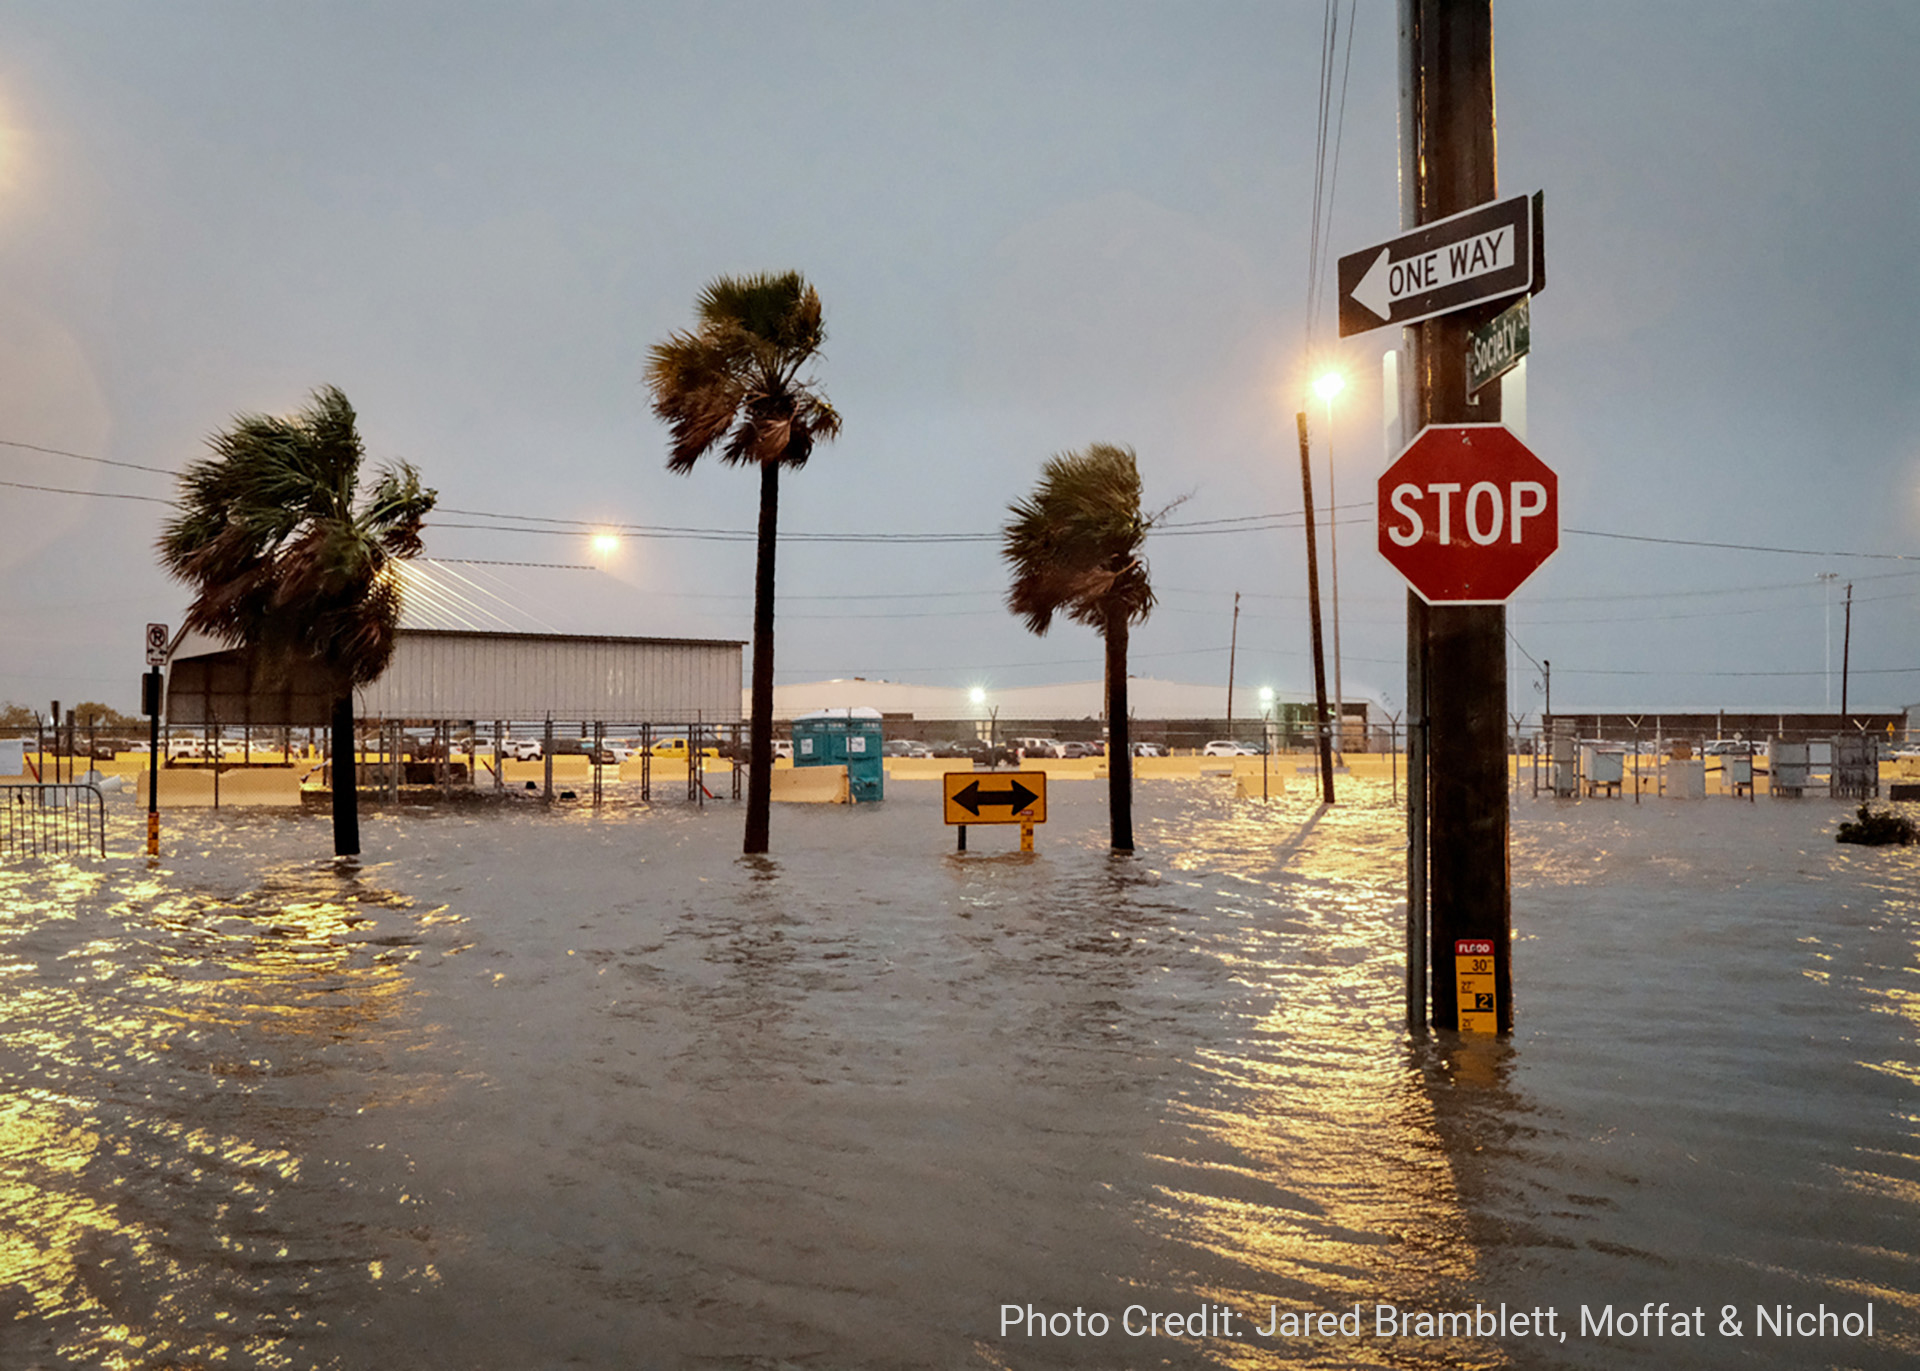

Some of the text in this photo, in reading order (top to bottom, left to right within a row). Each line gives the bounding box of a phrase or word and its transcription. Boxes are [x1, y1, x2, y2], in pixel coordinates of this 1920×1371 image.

[1389, 231, 1504, 296] ONE WAY
[1473, 319, 1517, 376] Society
[1388, 481, 1548, 547] STOP
